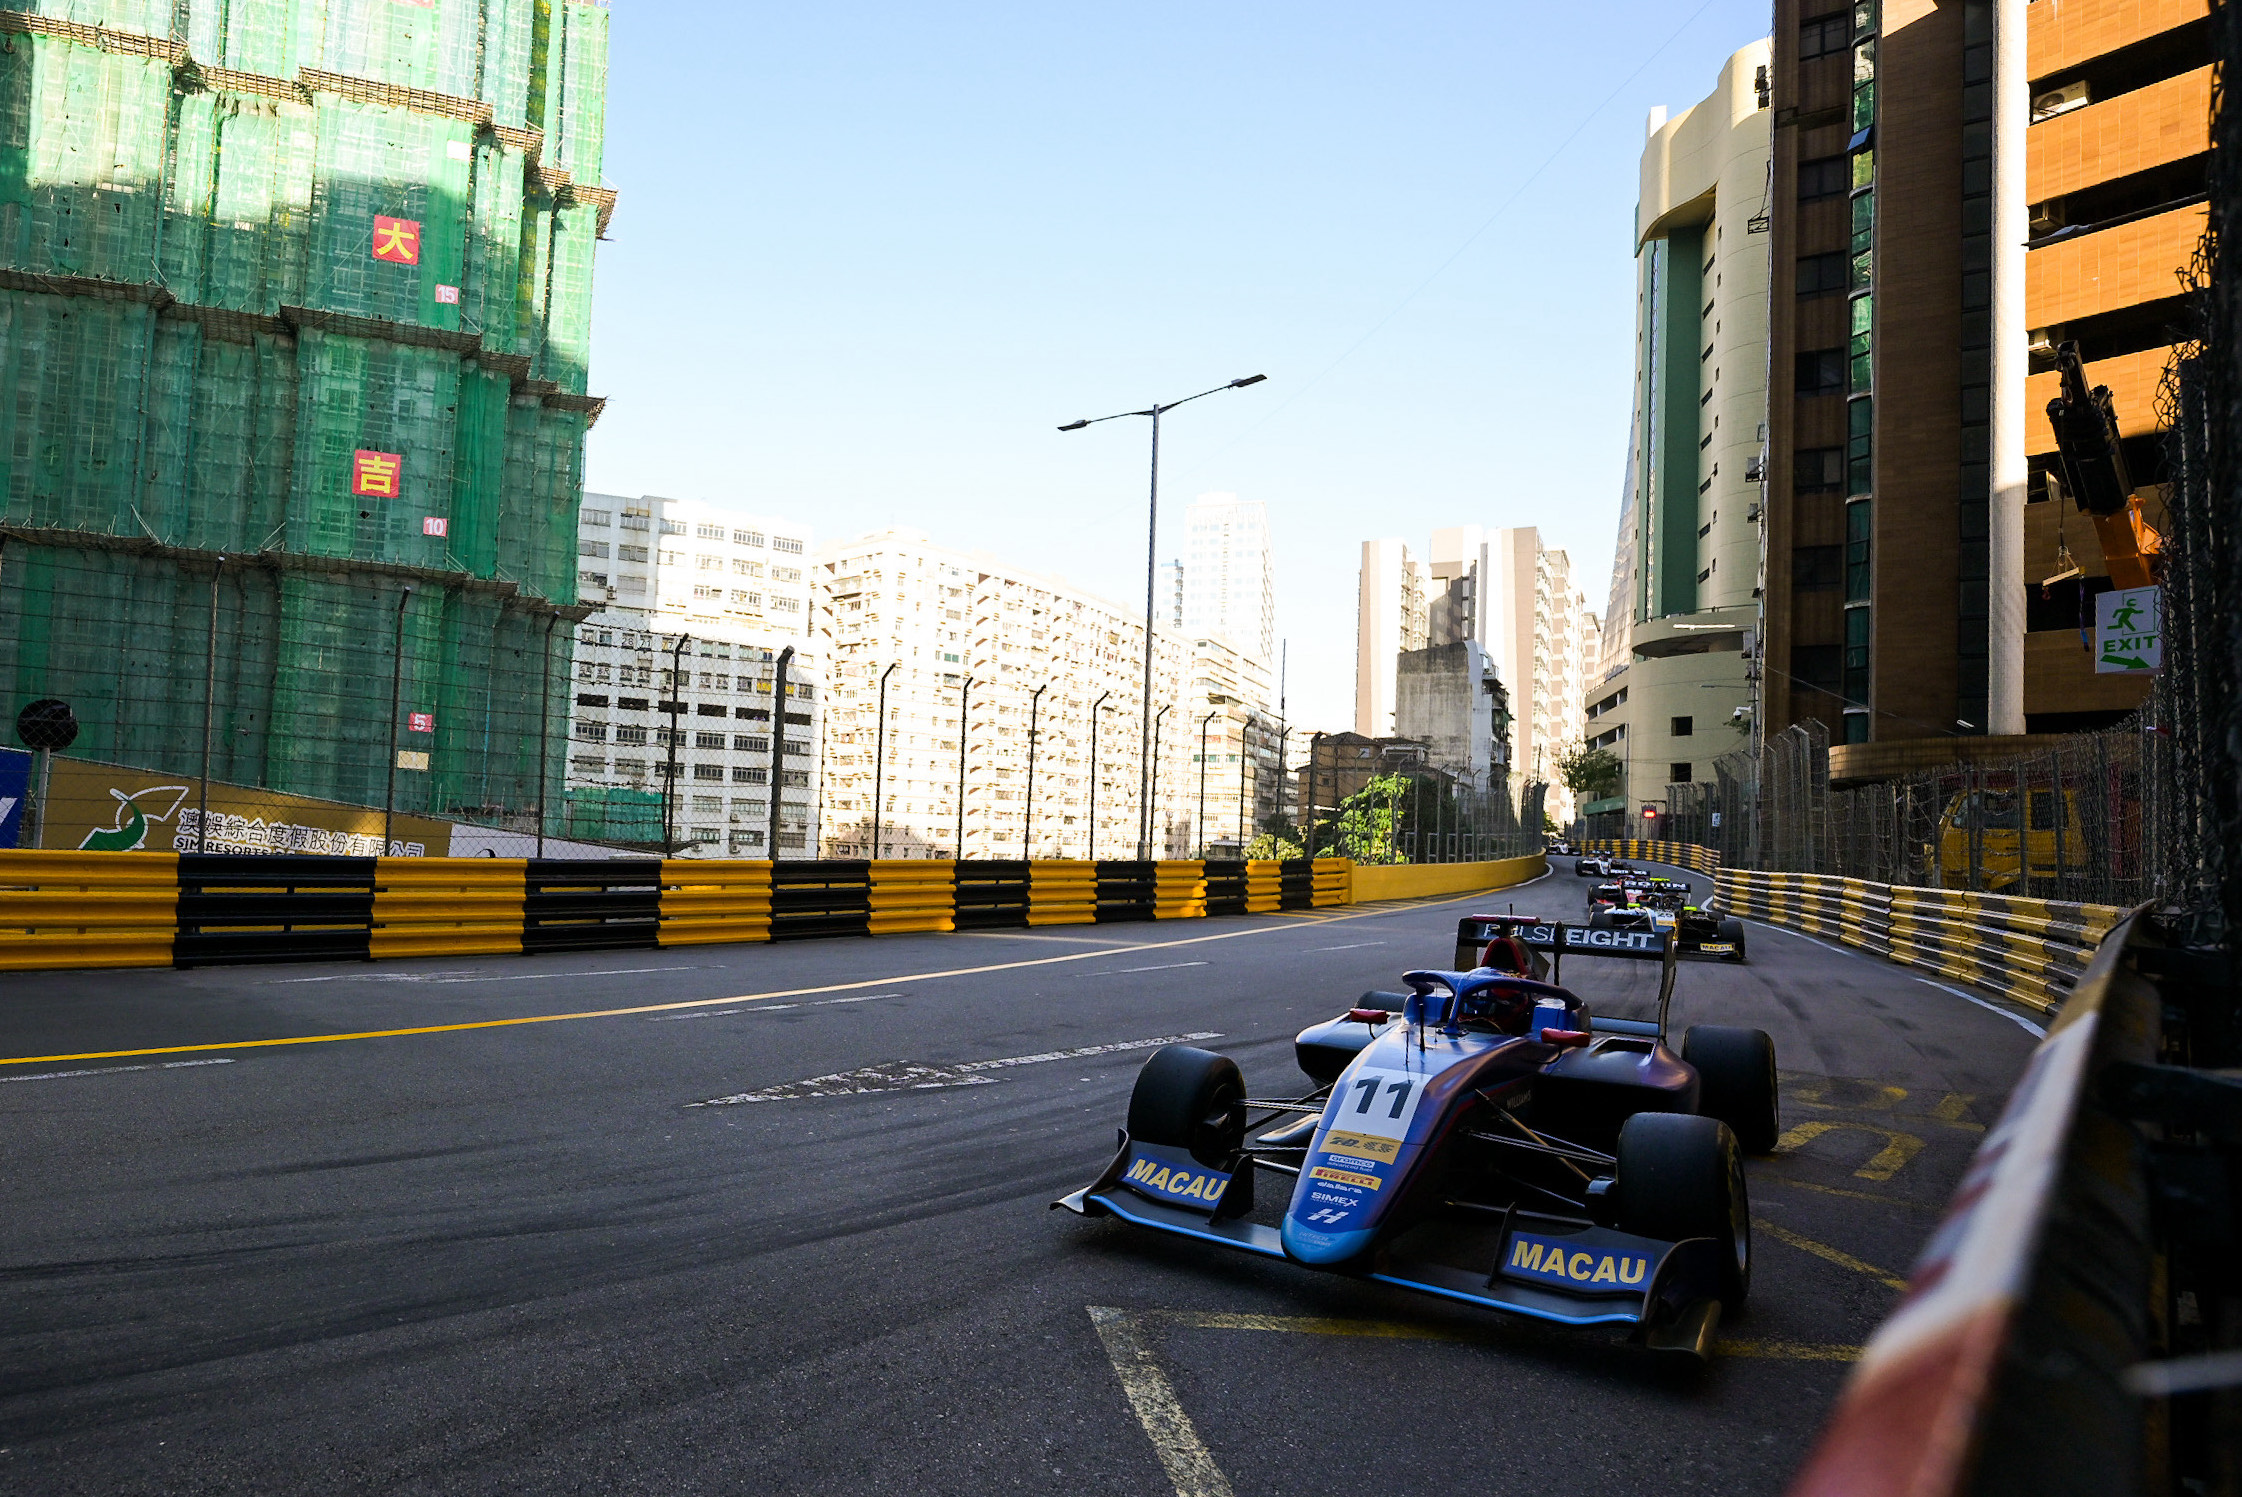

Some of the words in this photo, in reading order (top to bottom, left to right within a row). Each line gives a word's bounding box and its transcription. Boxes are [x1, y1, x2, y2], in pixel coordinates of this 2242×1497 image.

[376, 222, 415, 260] 大
[438, 287, 456, 303] 15
[358, 455, 396, 494] 吉
[426, 518, 444, 535] 10
[2104, 635, 2157, 653] EXIT
[414, 714, 426, 731] 5
[1702, 943, 1731, 951] MACAU
[1355, 1075, 1416, 1120] 11
[1331, 1155, 1373, 1168] aramco
[1126, 1158, 1228, 1201] MACAU
[1315, 1168, 1375, 1187] PIRELLI
[1311, 1191, 1359, 1207] SIMEX
[1511, 1240, 1646, 1284] MACAU
